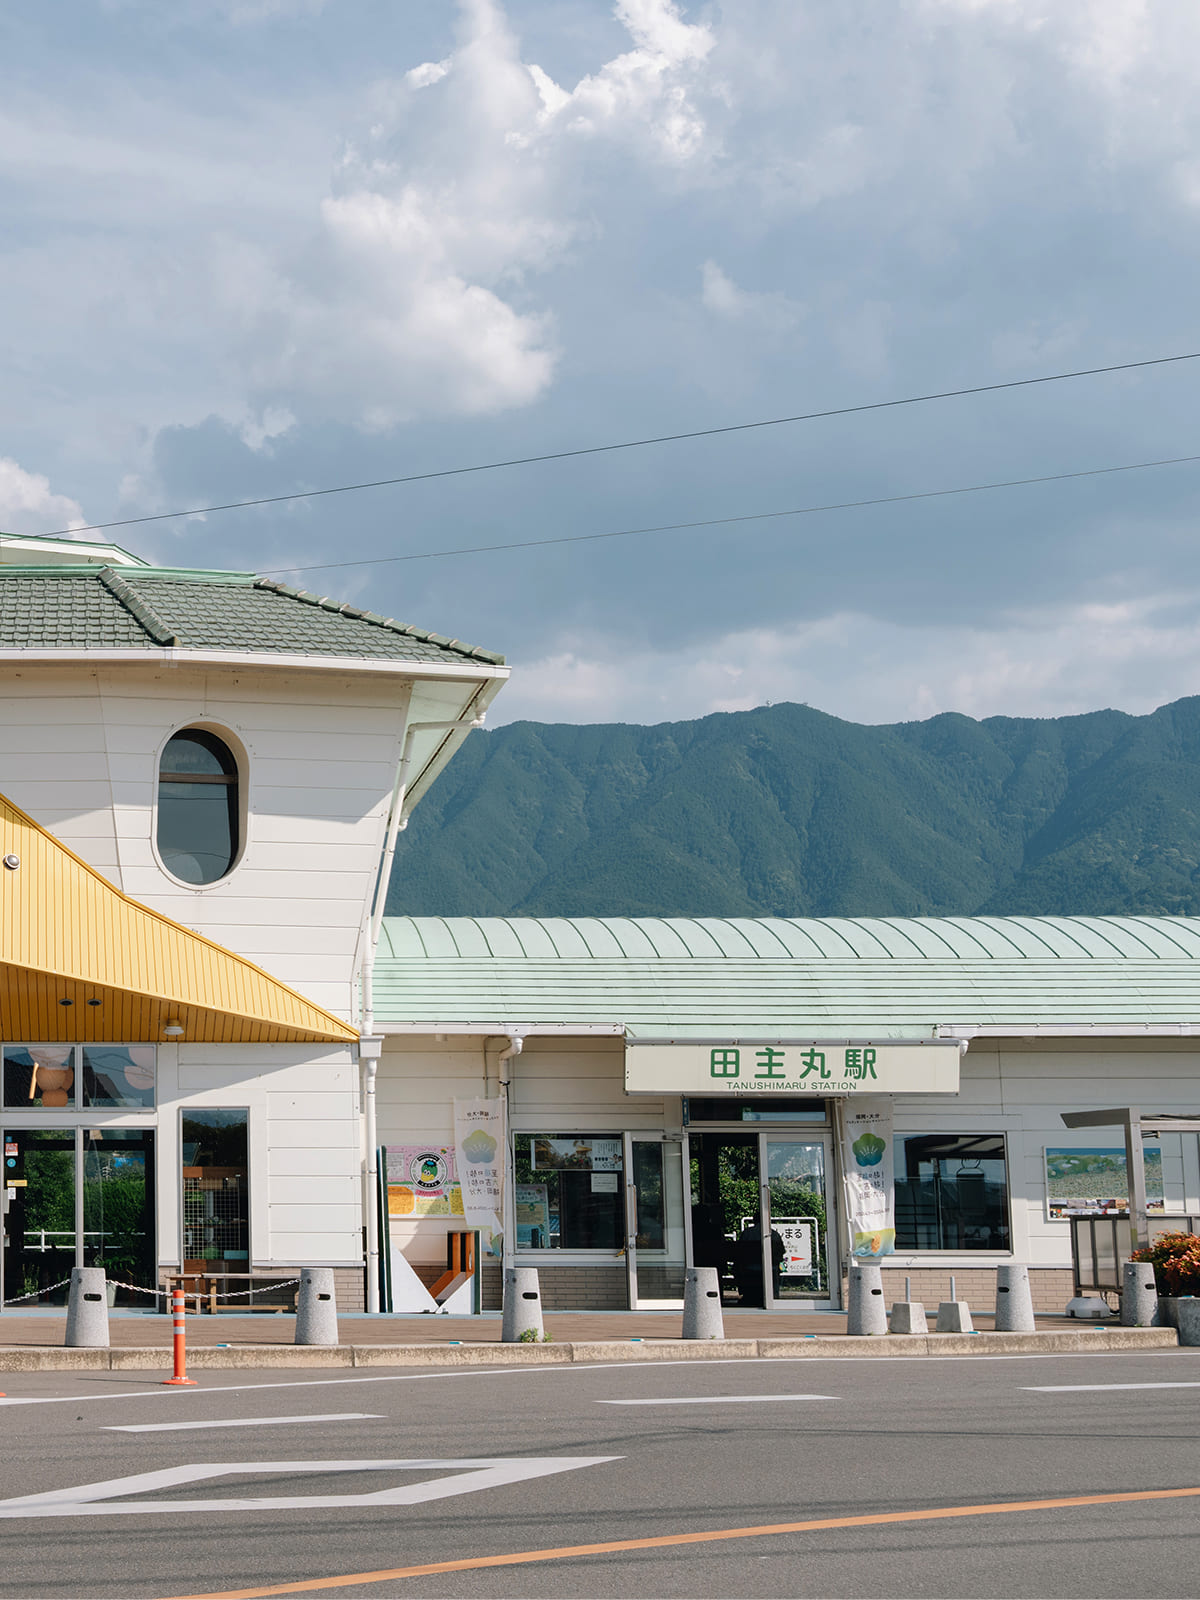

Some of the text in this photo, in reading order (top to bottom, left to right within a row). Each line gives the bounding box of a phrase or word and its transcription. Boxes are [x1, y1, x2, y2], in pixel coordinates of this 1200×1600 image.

[710, 1047, 878, 1080] 田主丸駅
[726, 1081, 858, 1090] TANUSHIMARU STATION
